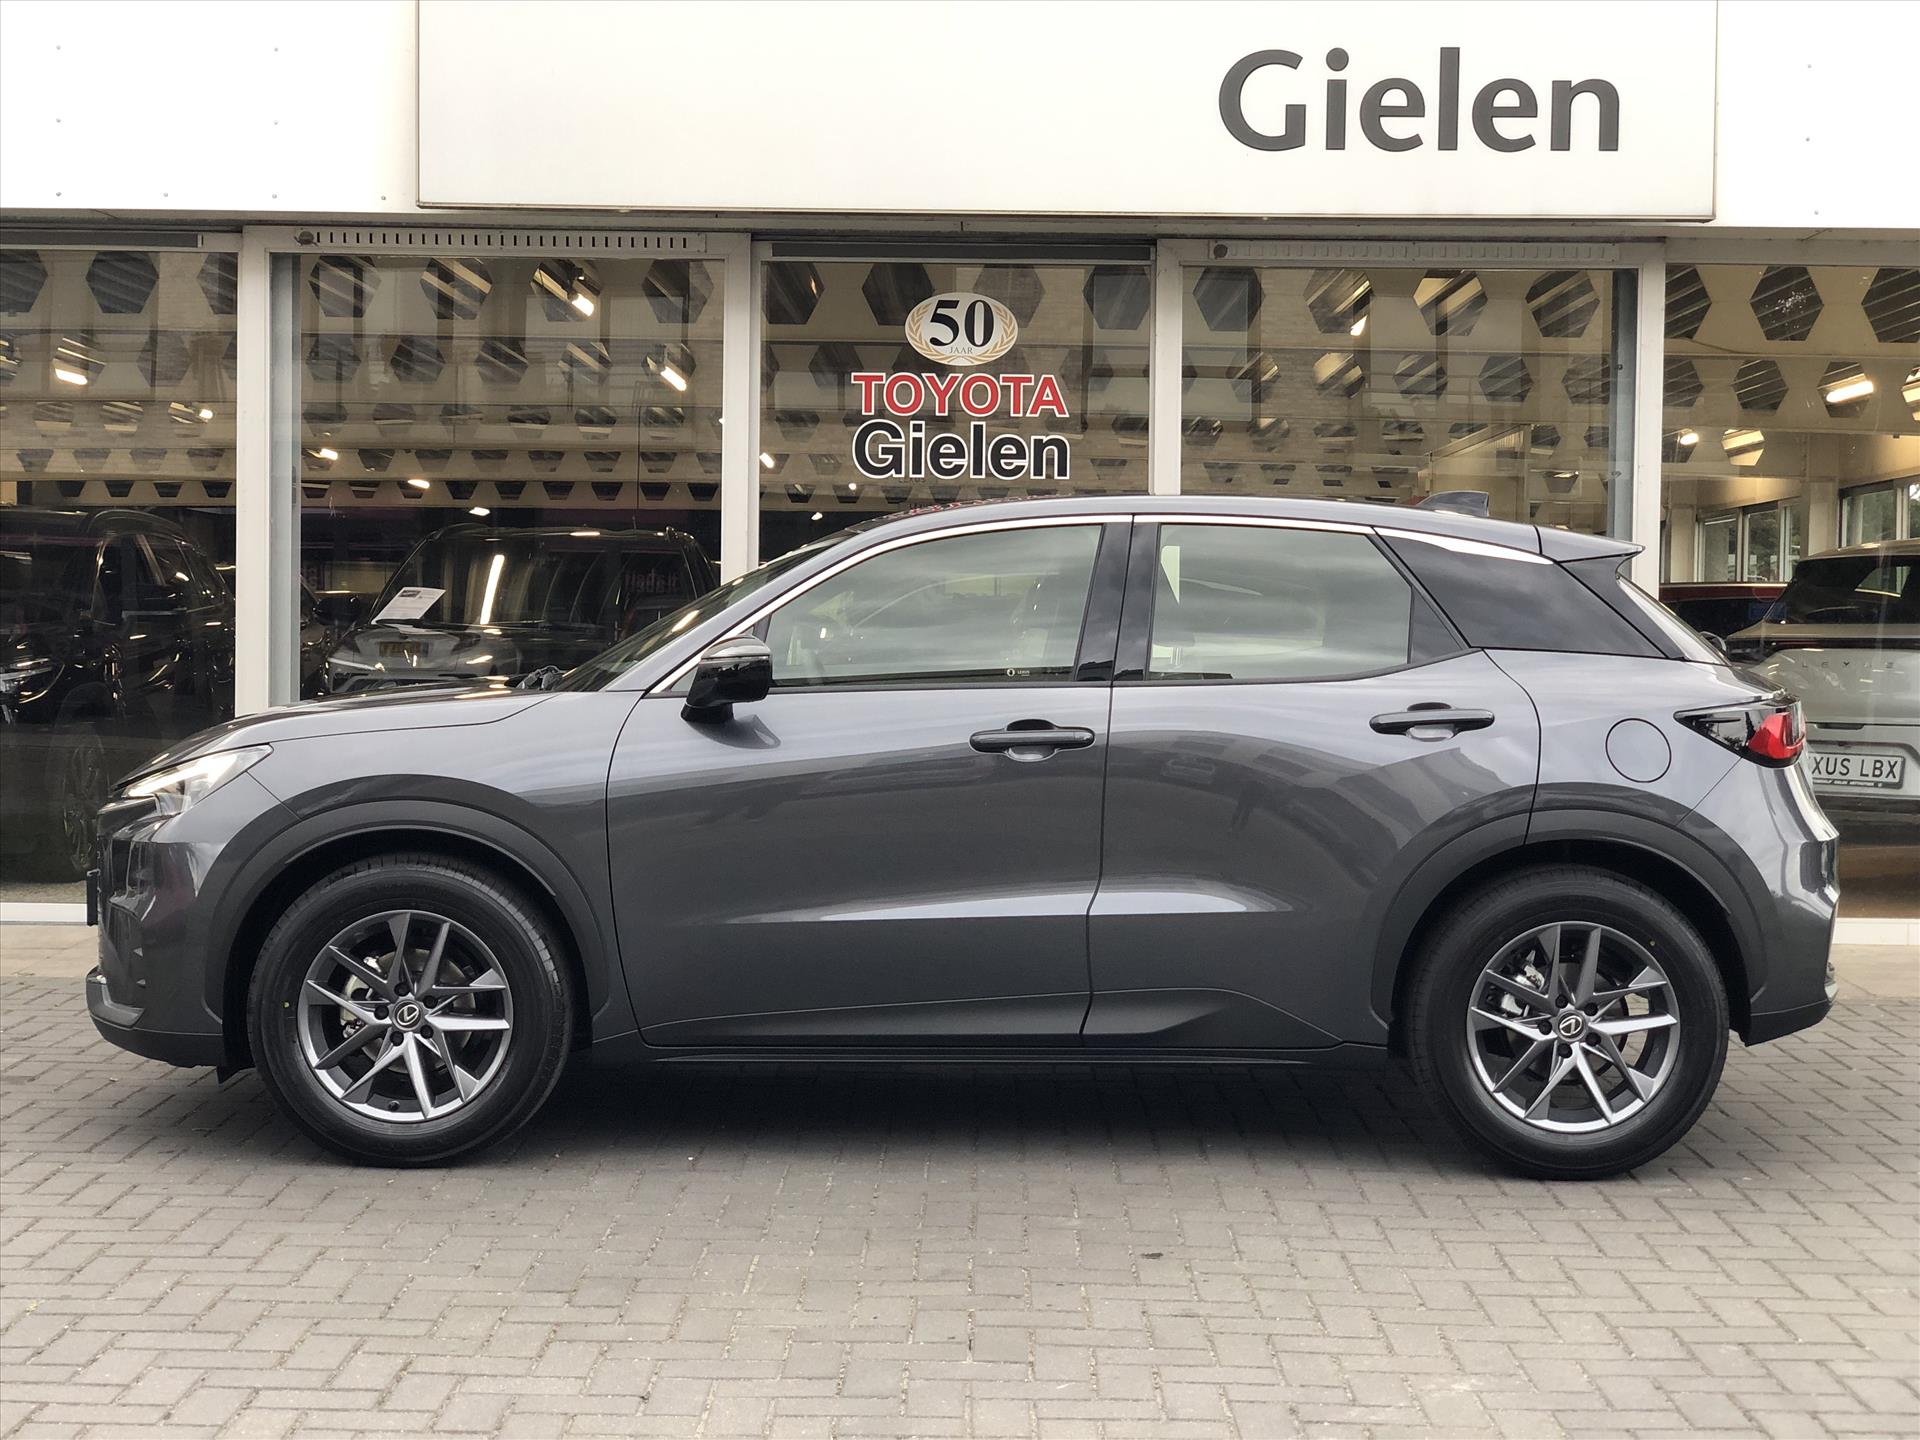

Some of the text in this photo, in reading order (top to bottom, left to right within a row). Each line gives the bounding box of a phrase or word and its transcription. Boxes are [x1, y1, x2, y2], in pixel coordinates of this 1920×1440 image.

[1218, 46, 1620, 153] Gielen
[929, 299, 994, 347] 50
[950, 346, 973, 355] JAAR
[851, 372, 1069, 418] TOYOTA
[852, 418, 1070, 480] Gielen
[1809, 756, 1898, 779] XUS LBX
